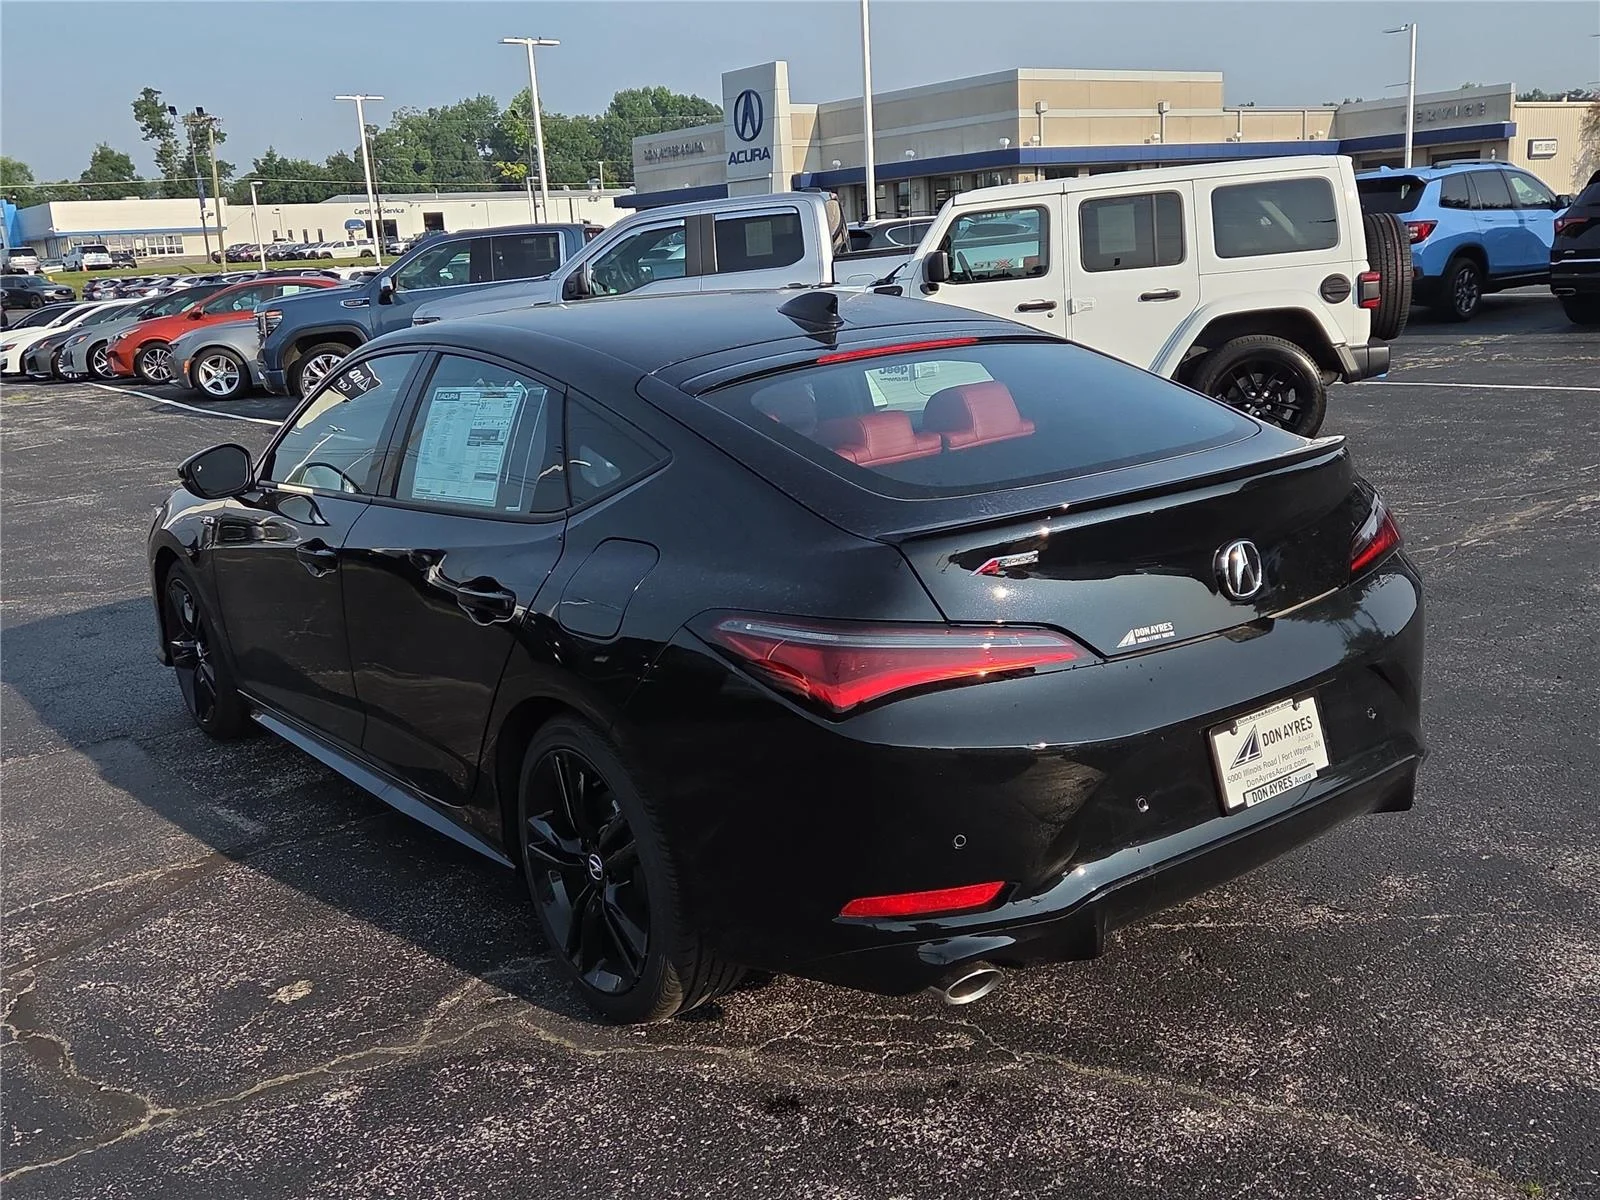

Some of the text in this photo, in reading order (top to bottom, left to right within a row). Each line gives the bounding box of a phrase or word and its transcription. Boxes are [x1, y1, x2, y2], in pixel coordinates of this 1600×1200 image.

[728, 146, 771, 165] ACURA
[879, 365, 908, 375] Jeep
[1134, 622, 1174, 637] DON AYRES
[1237, 700, 1292, 724] DonAyresAcura.com
[1262, 715, 1313, 747] DON AYRES
[1298, 732, 1314, 743] Acura
[1227, 771, 1242, 784] 5000
[1243, 765, 1262, 777] Illinois
[1263, 758, 1278, 769] Road
[1281, 752, 1293, 761] Fort
[1314, 740, 1320, 748] IN
[1246, 757, 1308, 788] DonAyresAcura.com
[1251, 772, 1312, 803] DON AYRES Acura
